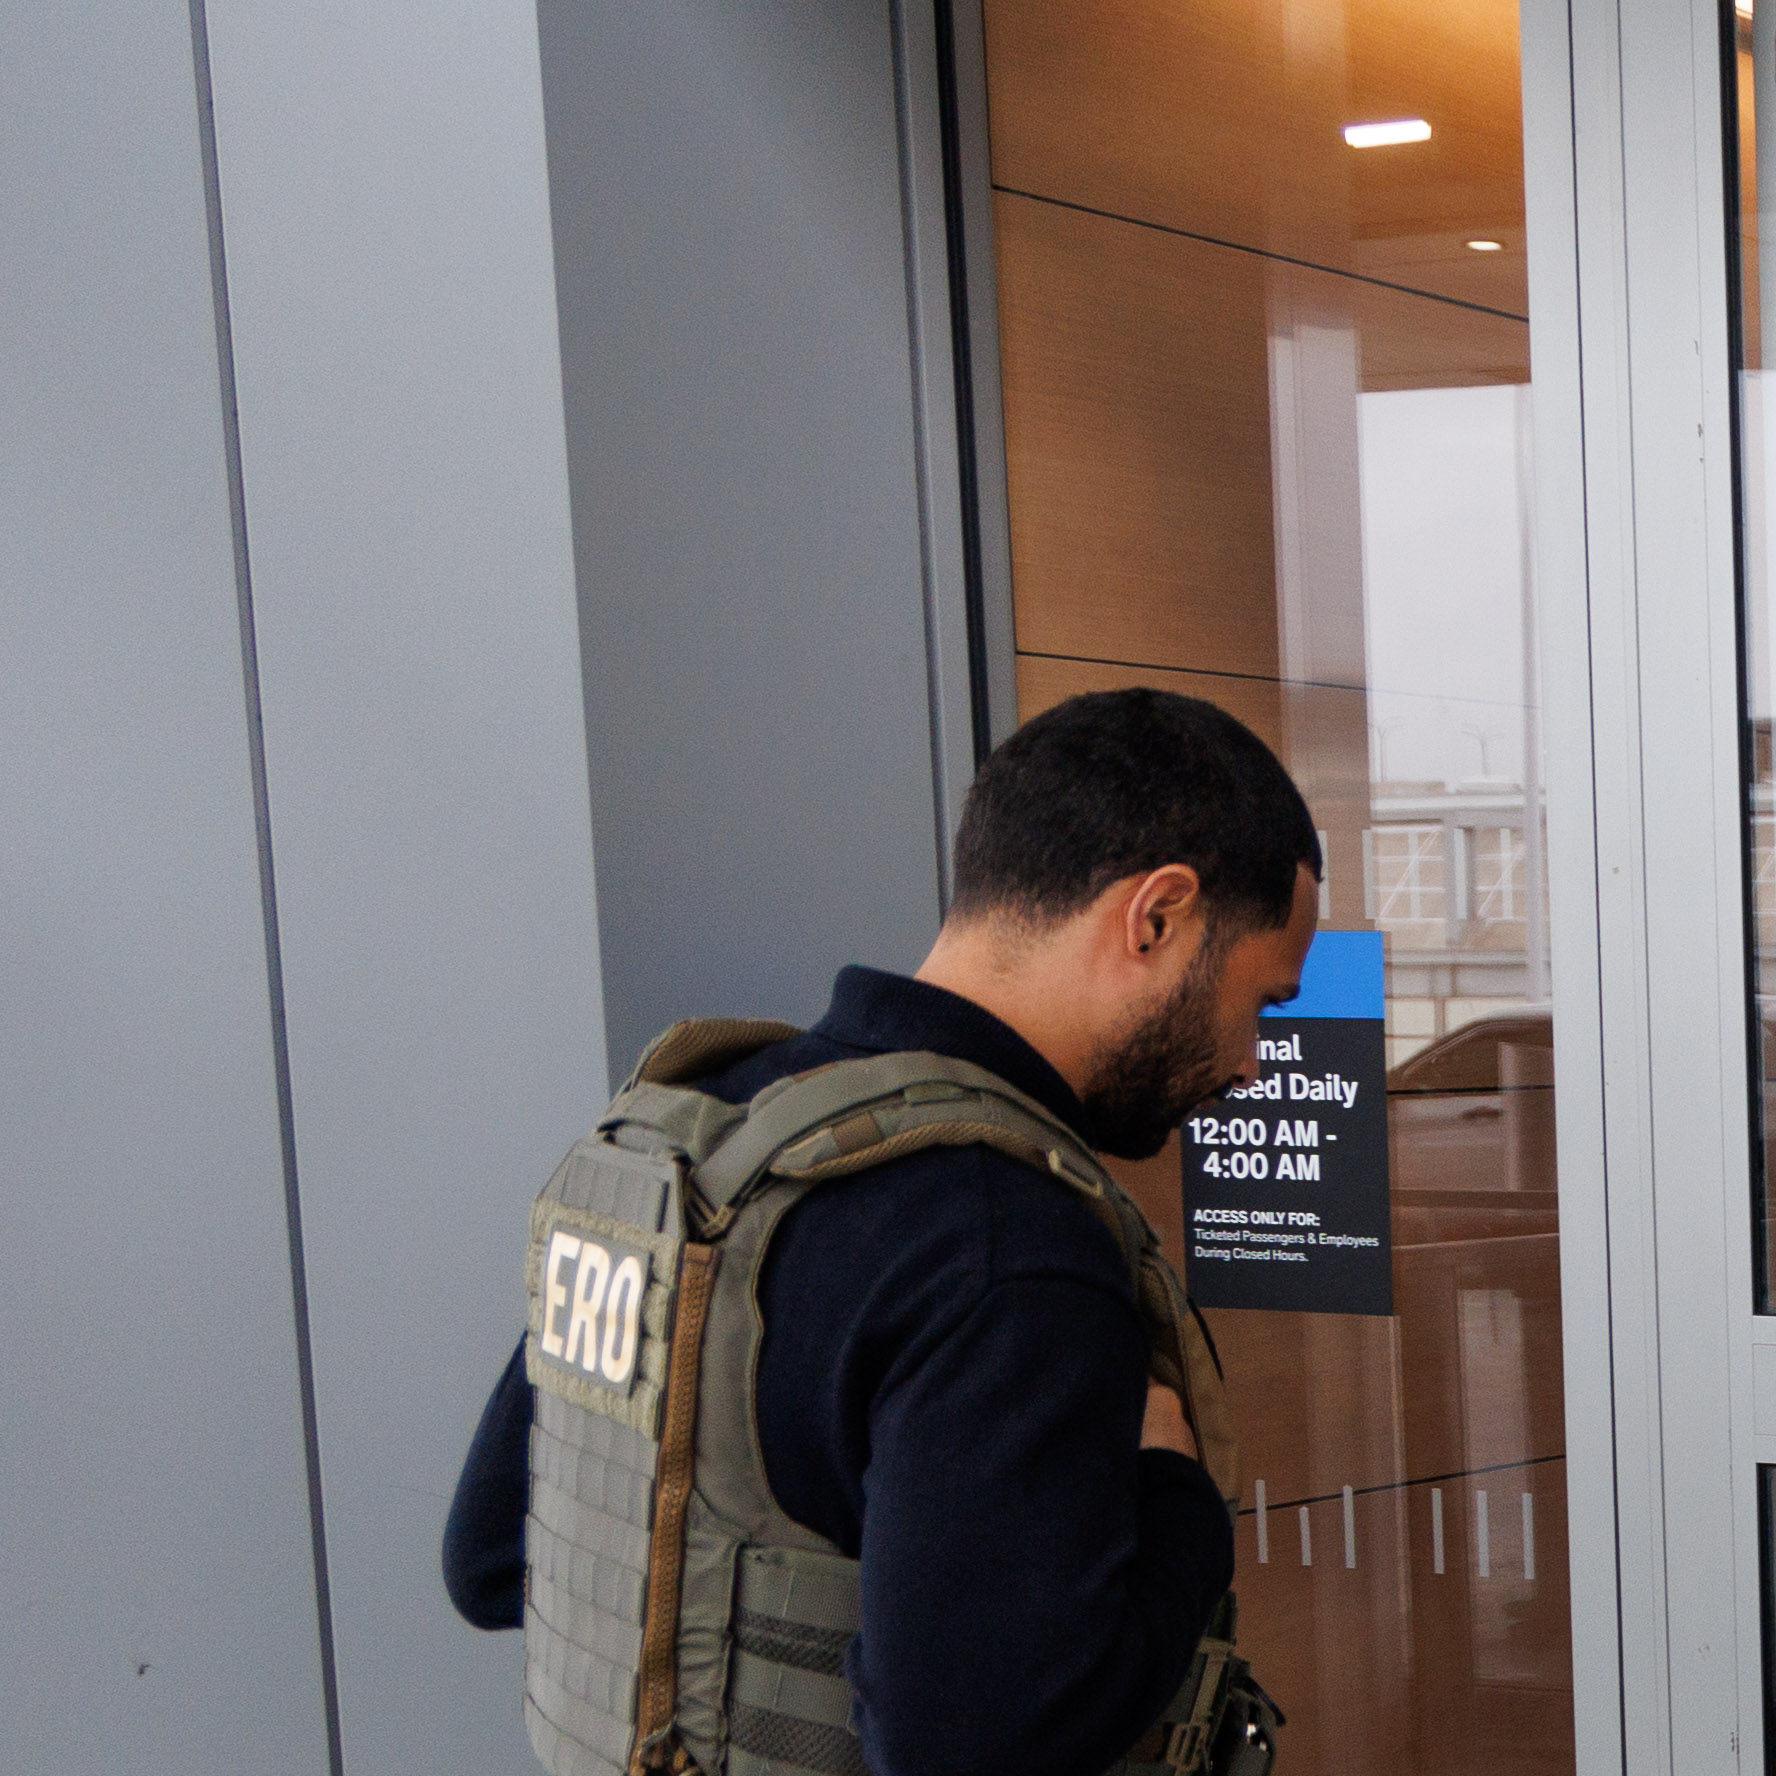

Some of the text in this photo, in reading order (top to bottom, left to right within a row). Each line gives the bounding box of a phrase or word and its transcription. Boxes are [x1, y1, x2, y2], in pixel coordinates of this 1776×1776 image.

[1289, 1073, 1358, 1108] Daily
[1188, 1118, 1267, 1146] 12:00
[1273, 1119, 1319, 1147] AM
[1203, 1151, 1321, 1181] 4:00 AM
[1193, 1209, 1321, 1227] ACCESS ONLY FOR:
[1194, 1228, 1379, 1248] Ticketed Passengers & Employees
[1195, 1246, 1309, 1262] During Closed Hours.
[542, 1231, 642, 1383] ERO
